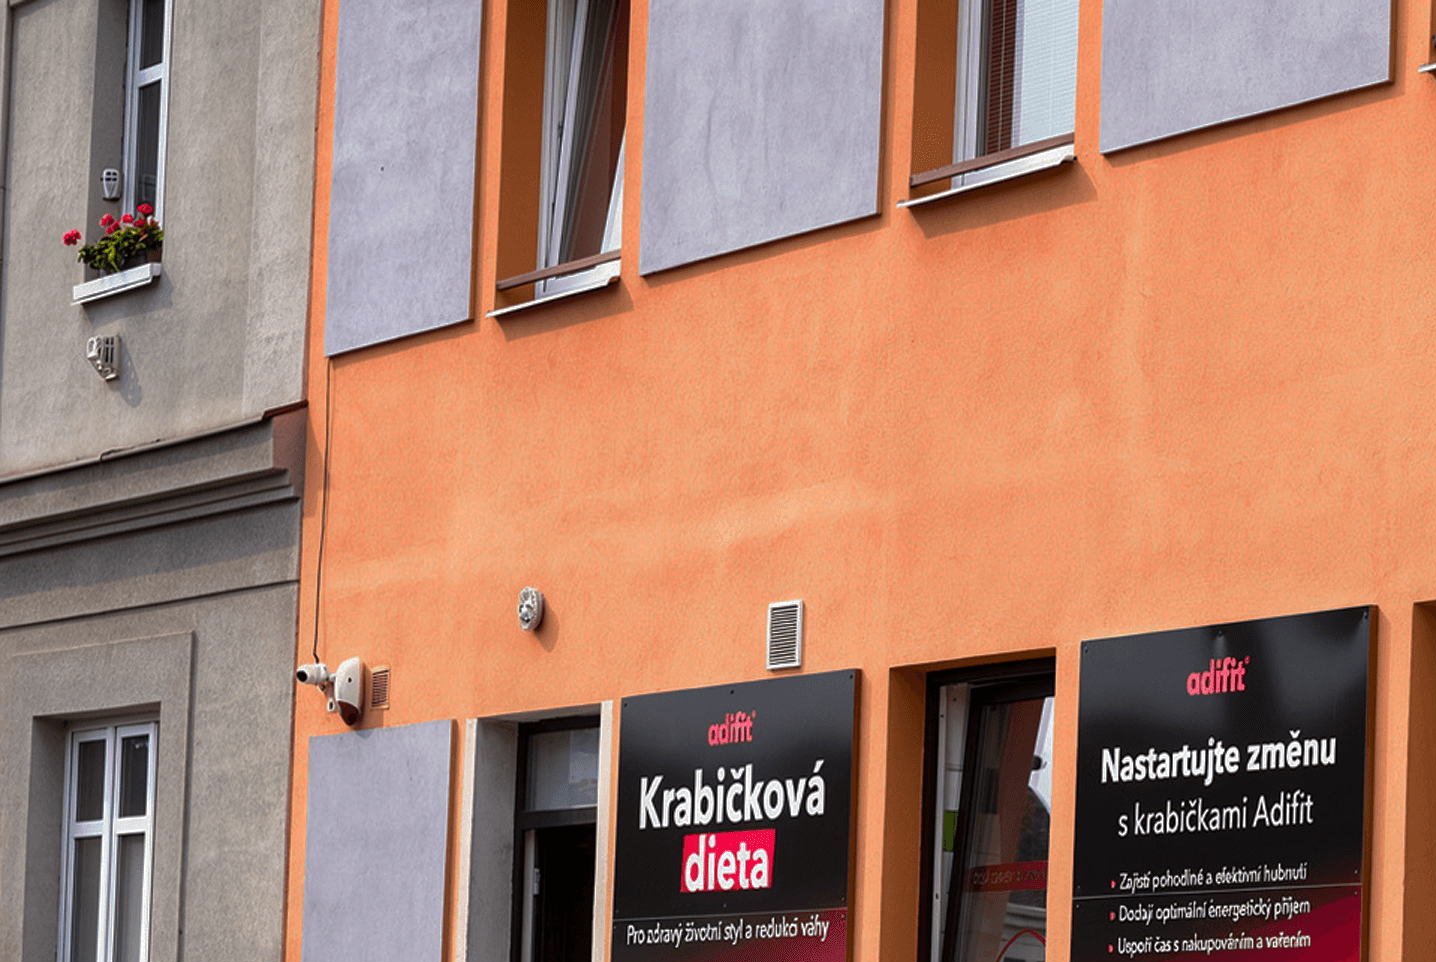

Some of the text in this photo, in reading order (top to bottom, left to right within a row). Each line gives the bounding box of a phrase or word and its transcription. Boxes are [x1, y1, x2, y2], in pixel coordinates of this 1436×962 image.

[1187, 656, 1246, 695] adifit
[708, 711, 753, 746] adifit
[1101, 730, 1337, 786] Nastartujte změnu
[639, 759, 825, 830] Krabičková
[1118, 790, 1314, 837] s krabičkami Adifit
[684, 834, 769, 893] dieta
[1205, 872, 1213, 885] a
[626, 924, 646, 945] Pro
[723, 918, 744, 945] styl
[745, 925, 752, 939] a
[1154, 936, 1171, 953] čas
[1173, 940, 1179, 952] s
[1256, 936, 1263, 949] a
